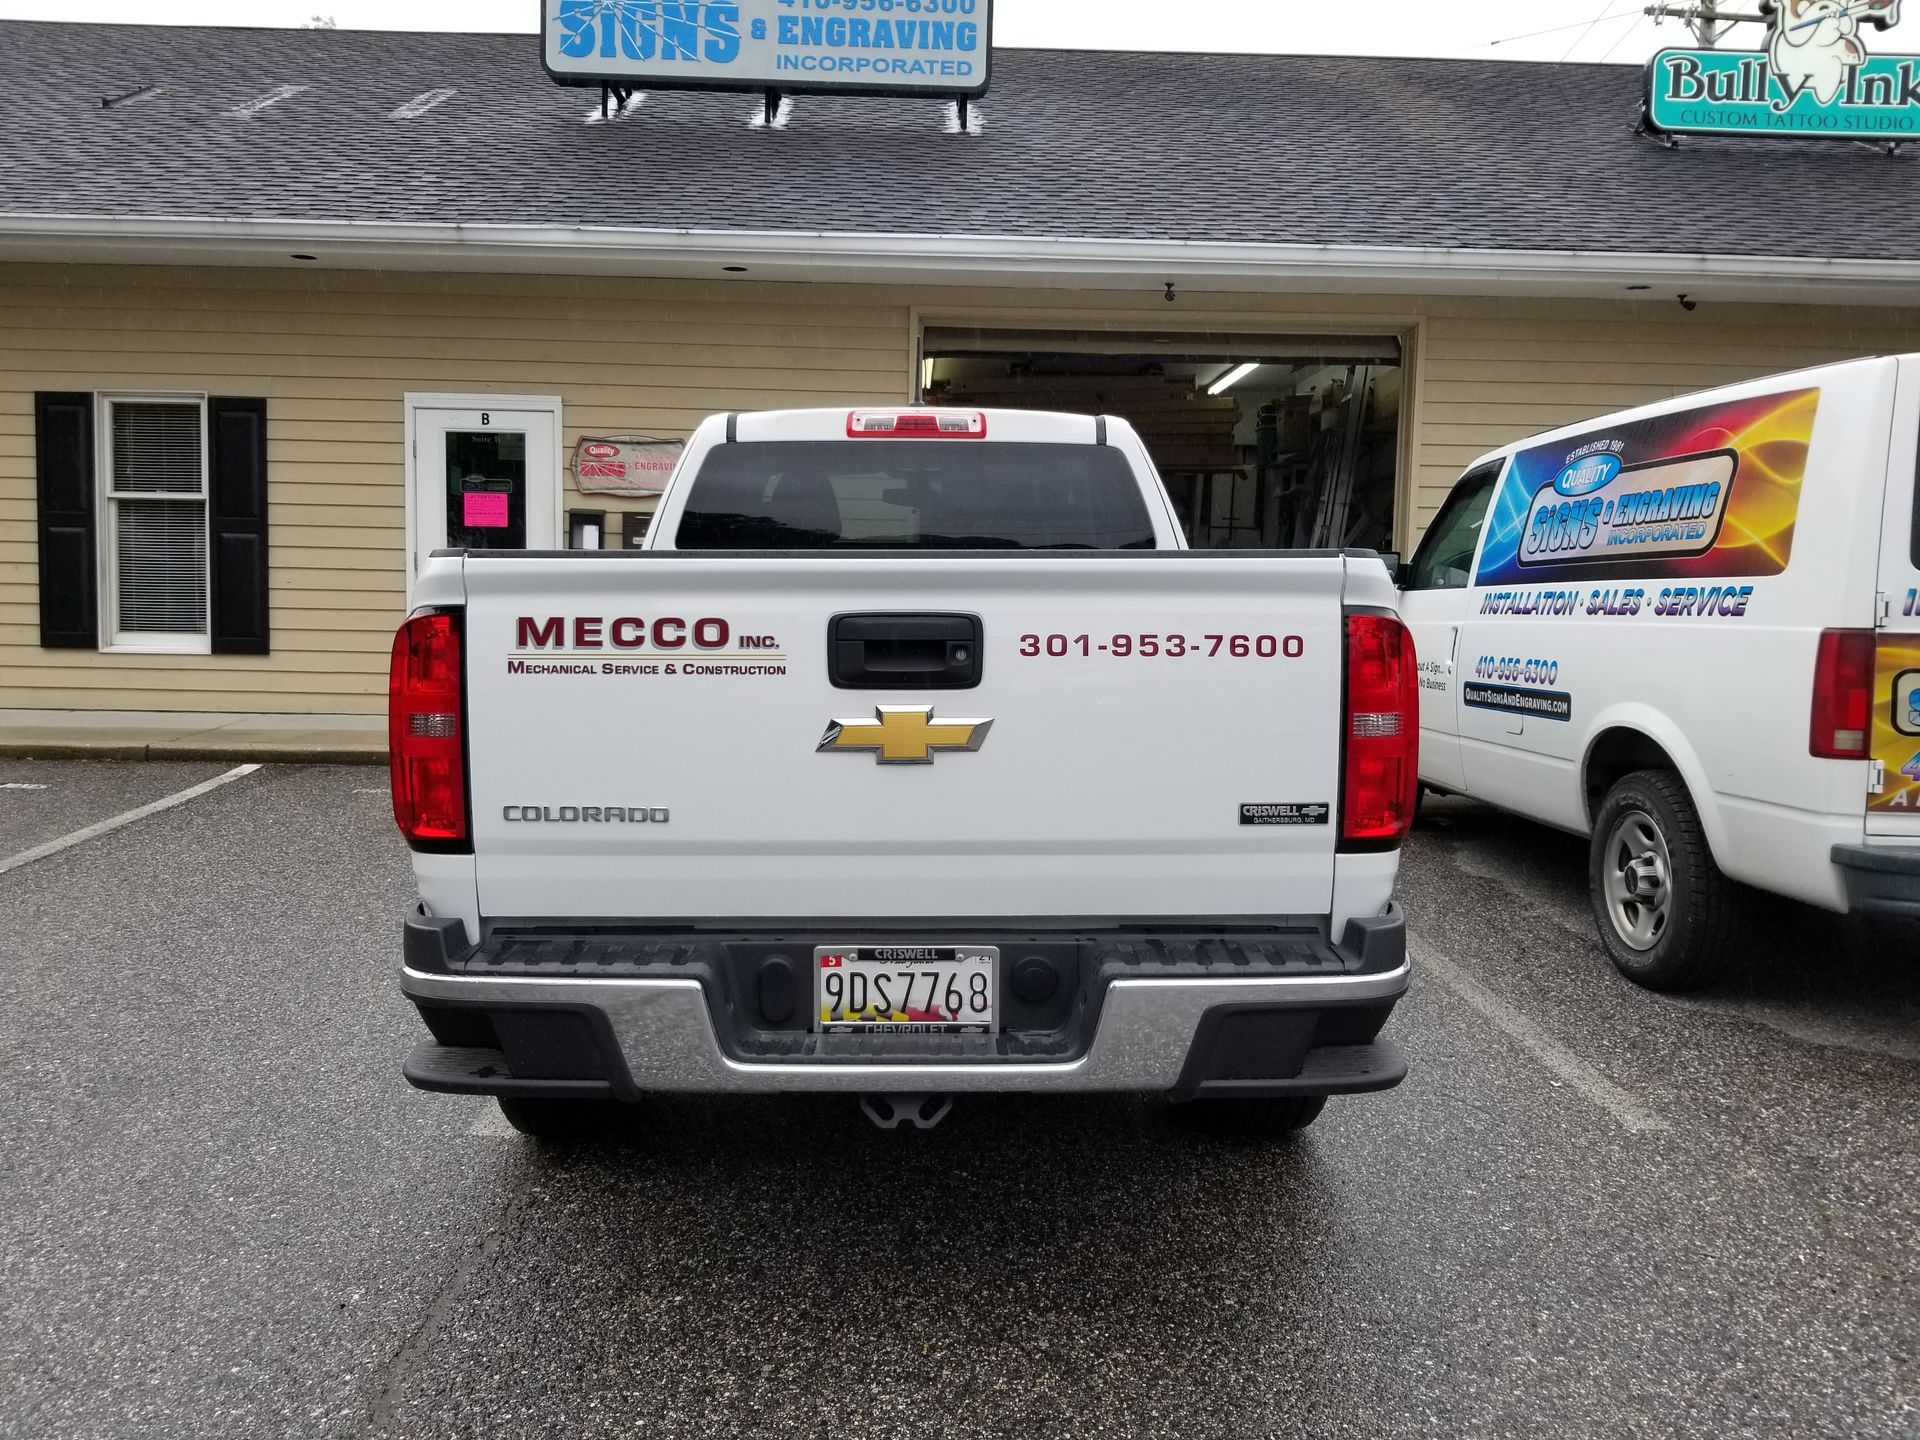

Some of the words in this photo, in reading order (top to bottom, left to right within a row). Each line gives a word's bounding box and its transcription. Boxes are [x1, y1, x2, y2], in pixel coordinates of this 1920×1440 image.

[751, 18, 767, 40] &
[777, 15, 977, 51] ENGRAVING
[776, 54, 973, 76] INCORPORATED
[1665, 56, 1815, 112] Bully
[1840, 61, 1920, 107] Ink
[1681, 109, 1758, 126] CUSTOM
[1763, 112, 1838, 129] TATTOO
[1844, 115, 1914, 131] STUDIO
[481, 412, 490, 426] B
[589, 446, 615, 456] Quality
[1566, 440, 1610, 464] ESTABLISHED
[1610, 439, 1625, 453] 1981
[1562, 463, 1612, 489] QUALITY
[1612, 481, 1721, 528] ENGRAVING
[1606, 521, 1708, 546] INCORPORATED
[1479, 591, 1580, 616] INSTALLATION
[1585, 588, 1642, 617] SALES
[1654, 586, 1754, 617] SERVICE
[515, 616, 730, 650] MECCO
[738, 635, 781, 650] INC.
[1019, 634, 1305, 658] 301-953-7600
[507, 660, 597, 675] MECHANICAL
[601, 663, 660, 675] SERVICE
[664, 663, 678, 675] &
[682, 663, 787, 676] CONSTRUCTION
[1474, 655, 1559, 686] 410-956-6300
[502, 805, 670, 824] COLORADO
[1304, 816, 1315, 824] MD
[825, 971, 988, 1014] 9DS7768
[864, 1024, 948, 1035] CHEVROLET
